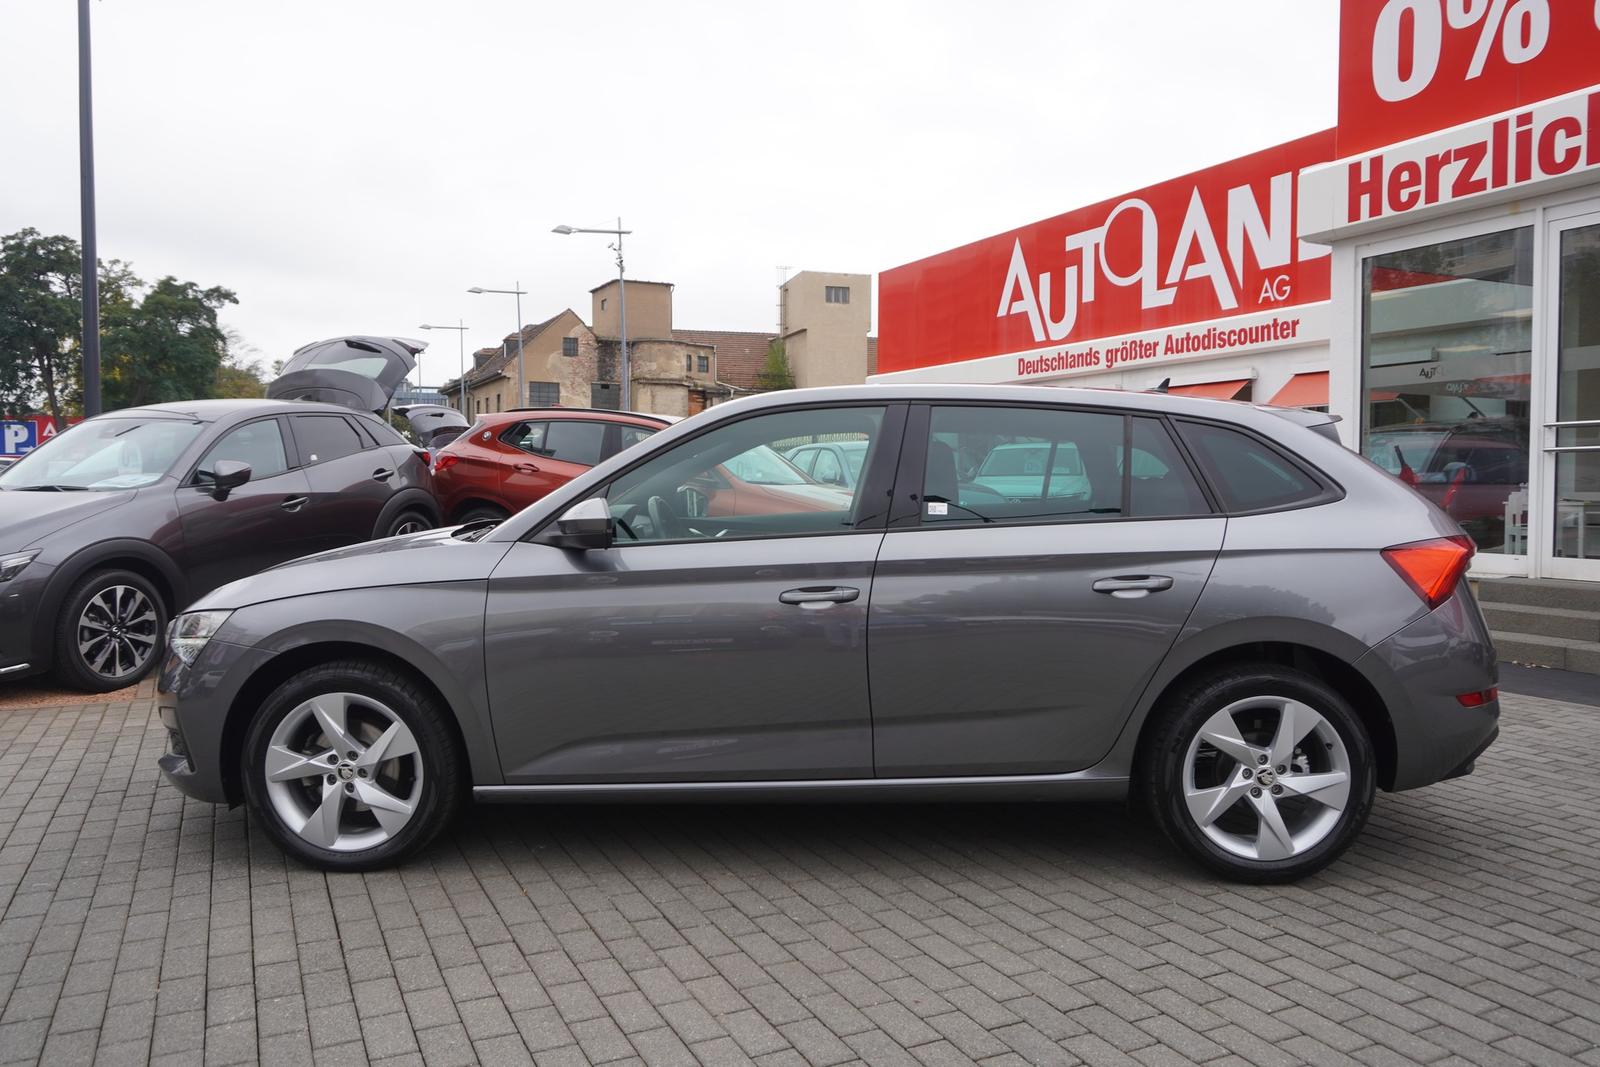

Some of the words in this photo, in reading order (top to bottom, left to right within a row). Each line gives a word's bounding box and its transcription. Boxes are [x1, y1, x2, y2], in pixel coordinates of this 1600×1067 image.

[1258, 274, 1290, 304] AG
[1017, 347, 1100, 376] Deutschlands
[1105, 340, 1159, 369] größter
[1164, 317, 1300, 356] Autodiscounter
[4, 424, 29, 453] P
